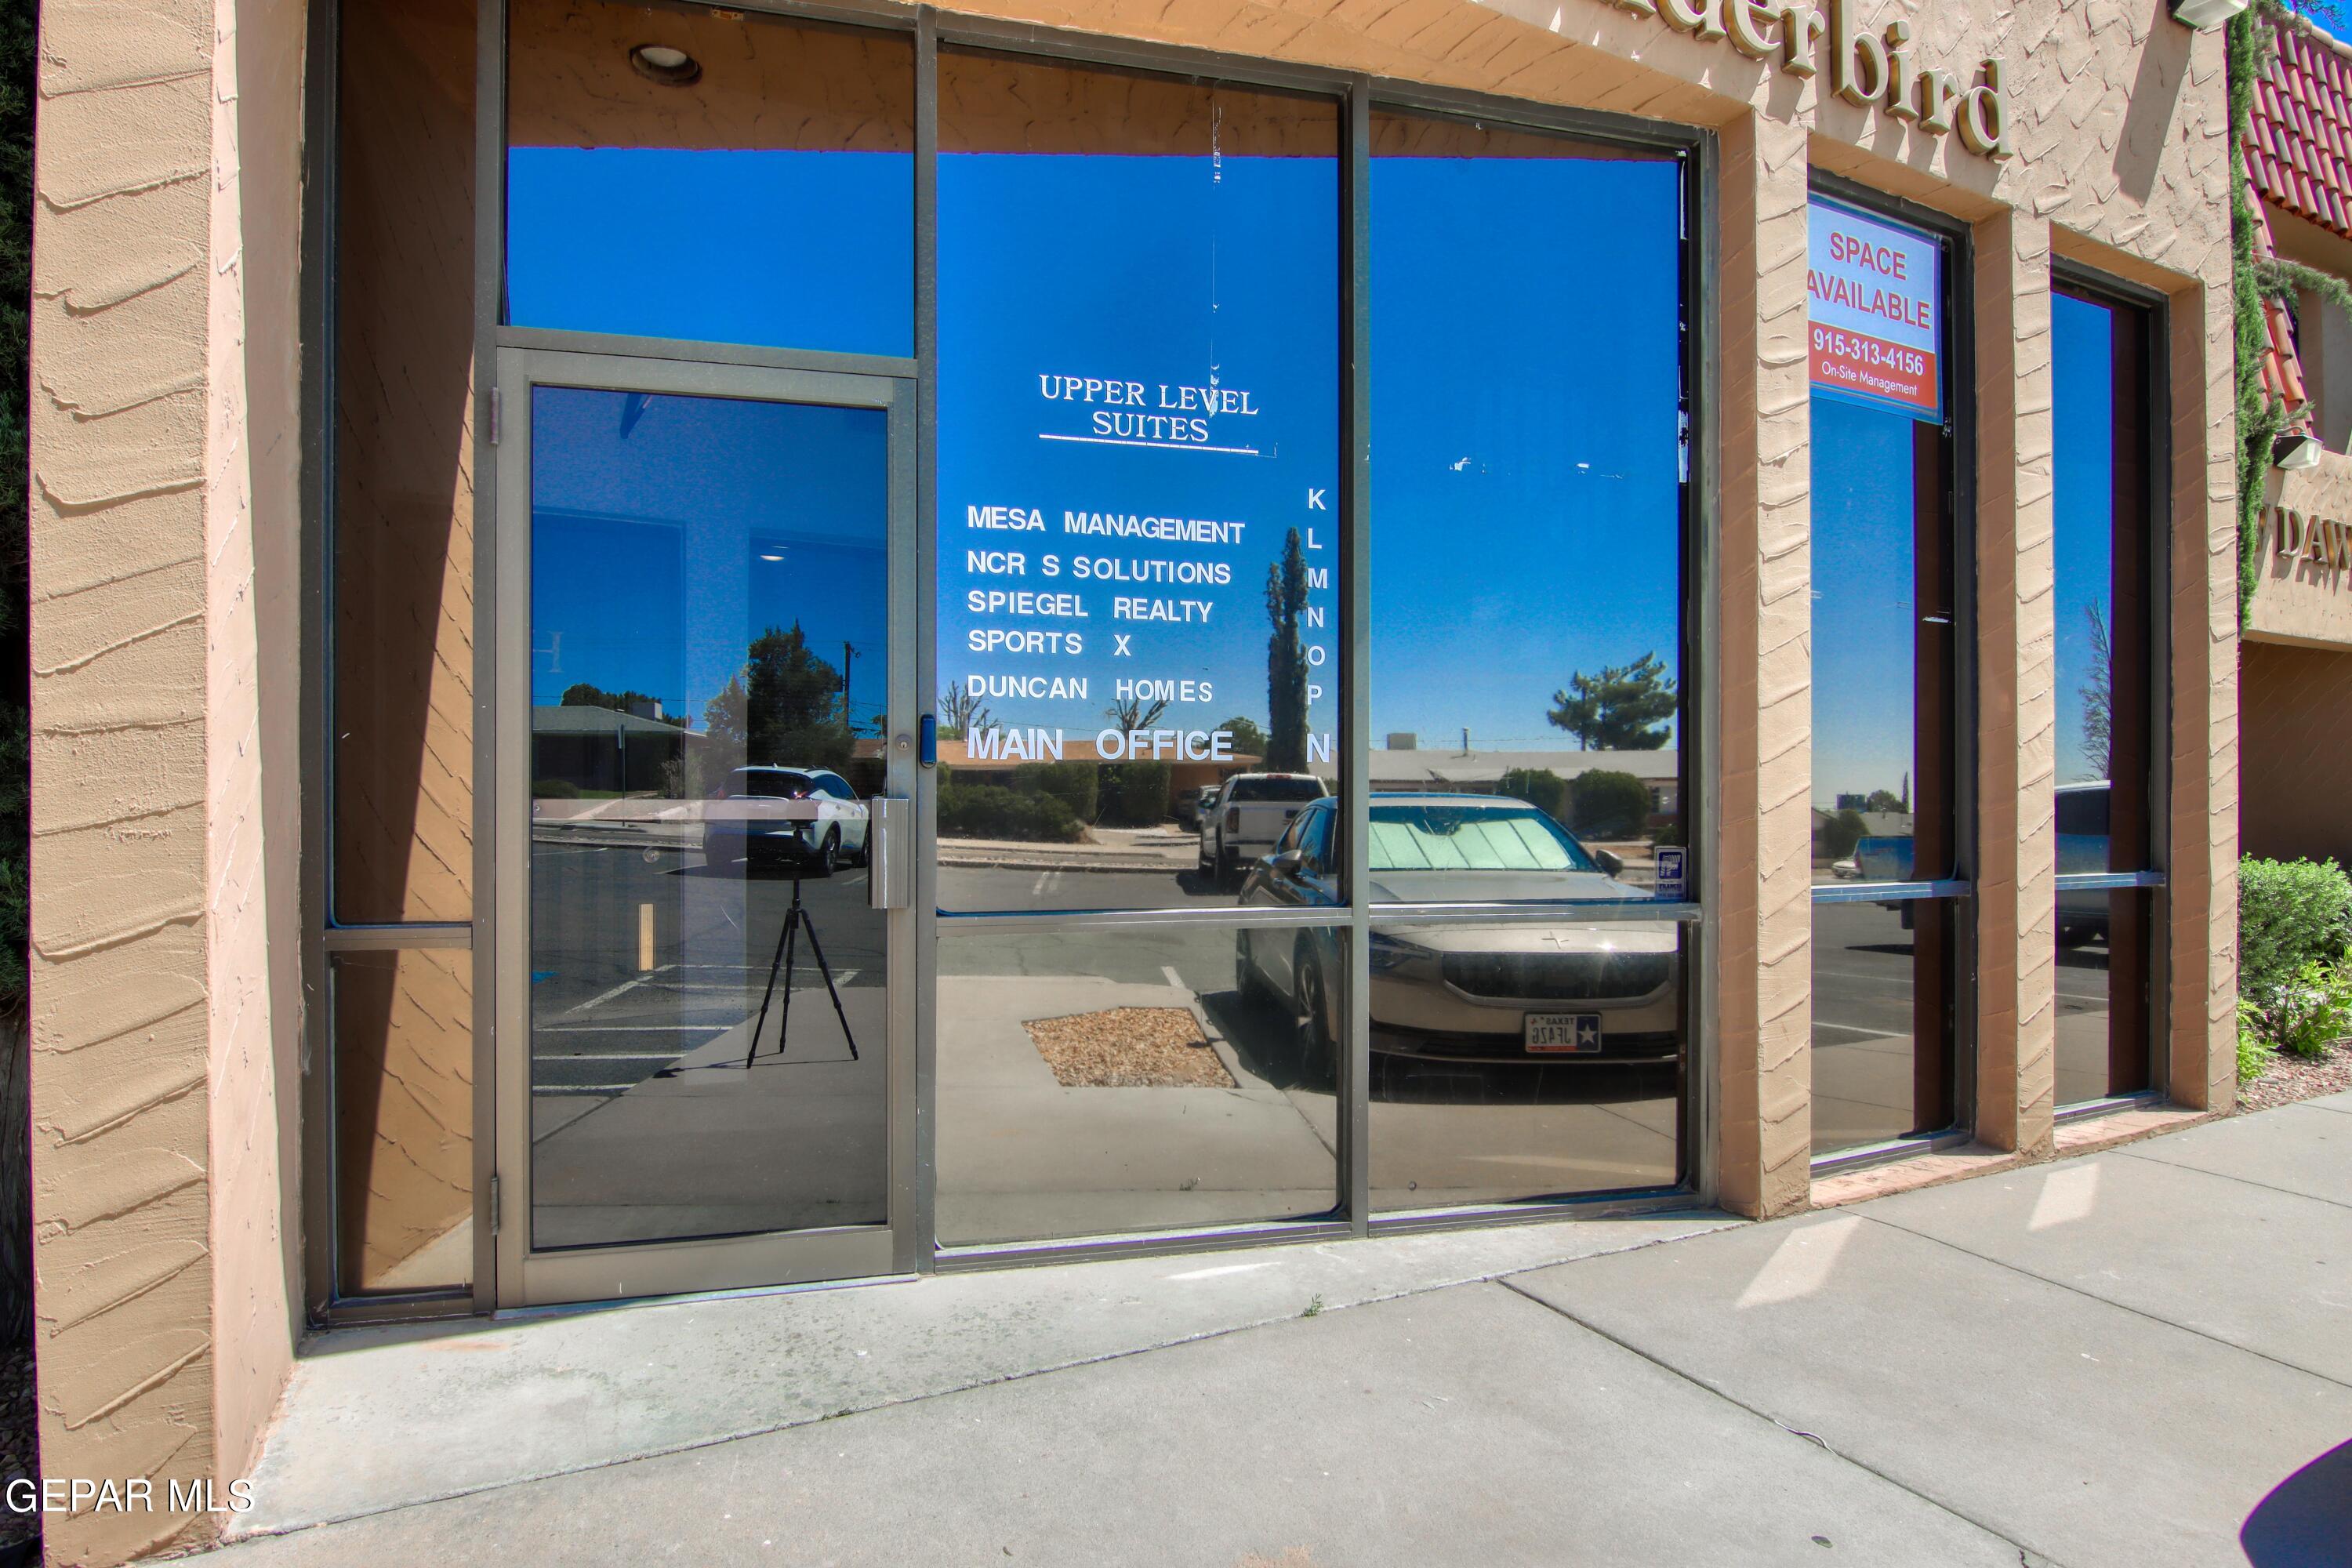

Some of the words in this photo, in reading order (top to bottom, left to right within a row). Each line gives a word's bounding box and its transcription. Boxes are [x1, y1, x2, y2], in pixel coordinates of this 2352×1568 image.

[1599, 0, 2013, 160] erbird
[1830, 232, 1907, 281] SPACE
[1807, 269, 1930, 329] AVAILABLE
[1813, 328, 1924, 376] 915-313-4156
[1039, 374, 1146, 406] UPPER
[1159, 384, 1259, 415] LEVEL
[1821, 361, 1857, 382] On-Site
[1859, 372, 1918, 396] Management
[1092, 411, 1209, 442] SUITES
[1308, 488, 1327, 510] K
[967, 506, 1046, 532] MESA
[1065, 511, 1245, 544] MANAGEMENT
[1308, 528, 1323, 549] L
[967, 550, 1025, 575] NCR
[1042, 555, 1060, 577] S
[1073, 556, 1232, 585] SOLUTIONS
[1308, 568, 1328, 590] M
[967, 590, 1088, 618] SPIEGEL
[1113, 597, 1214, 623] REALTY
[1308, 606, 1325, 628] N
[967, 630, 1083, 655] SPORTS
[1114, 634, 1131, 657] X
[1308, 645, 1327, 666] O
[967, 674, 1088, 699] DUNCAN
[1116, 678, 1214, 702] HOMES
[1308, 684, 1323, 706] P
[967, 727, 1064, 760] MAIN
[1096, 728, 1234, 761] OFFICE
[1307, 733, 1330, 764] N
